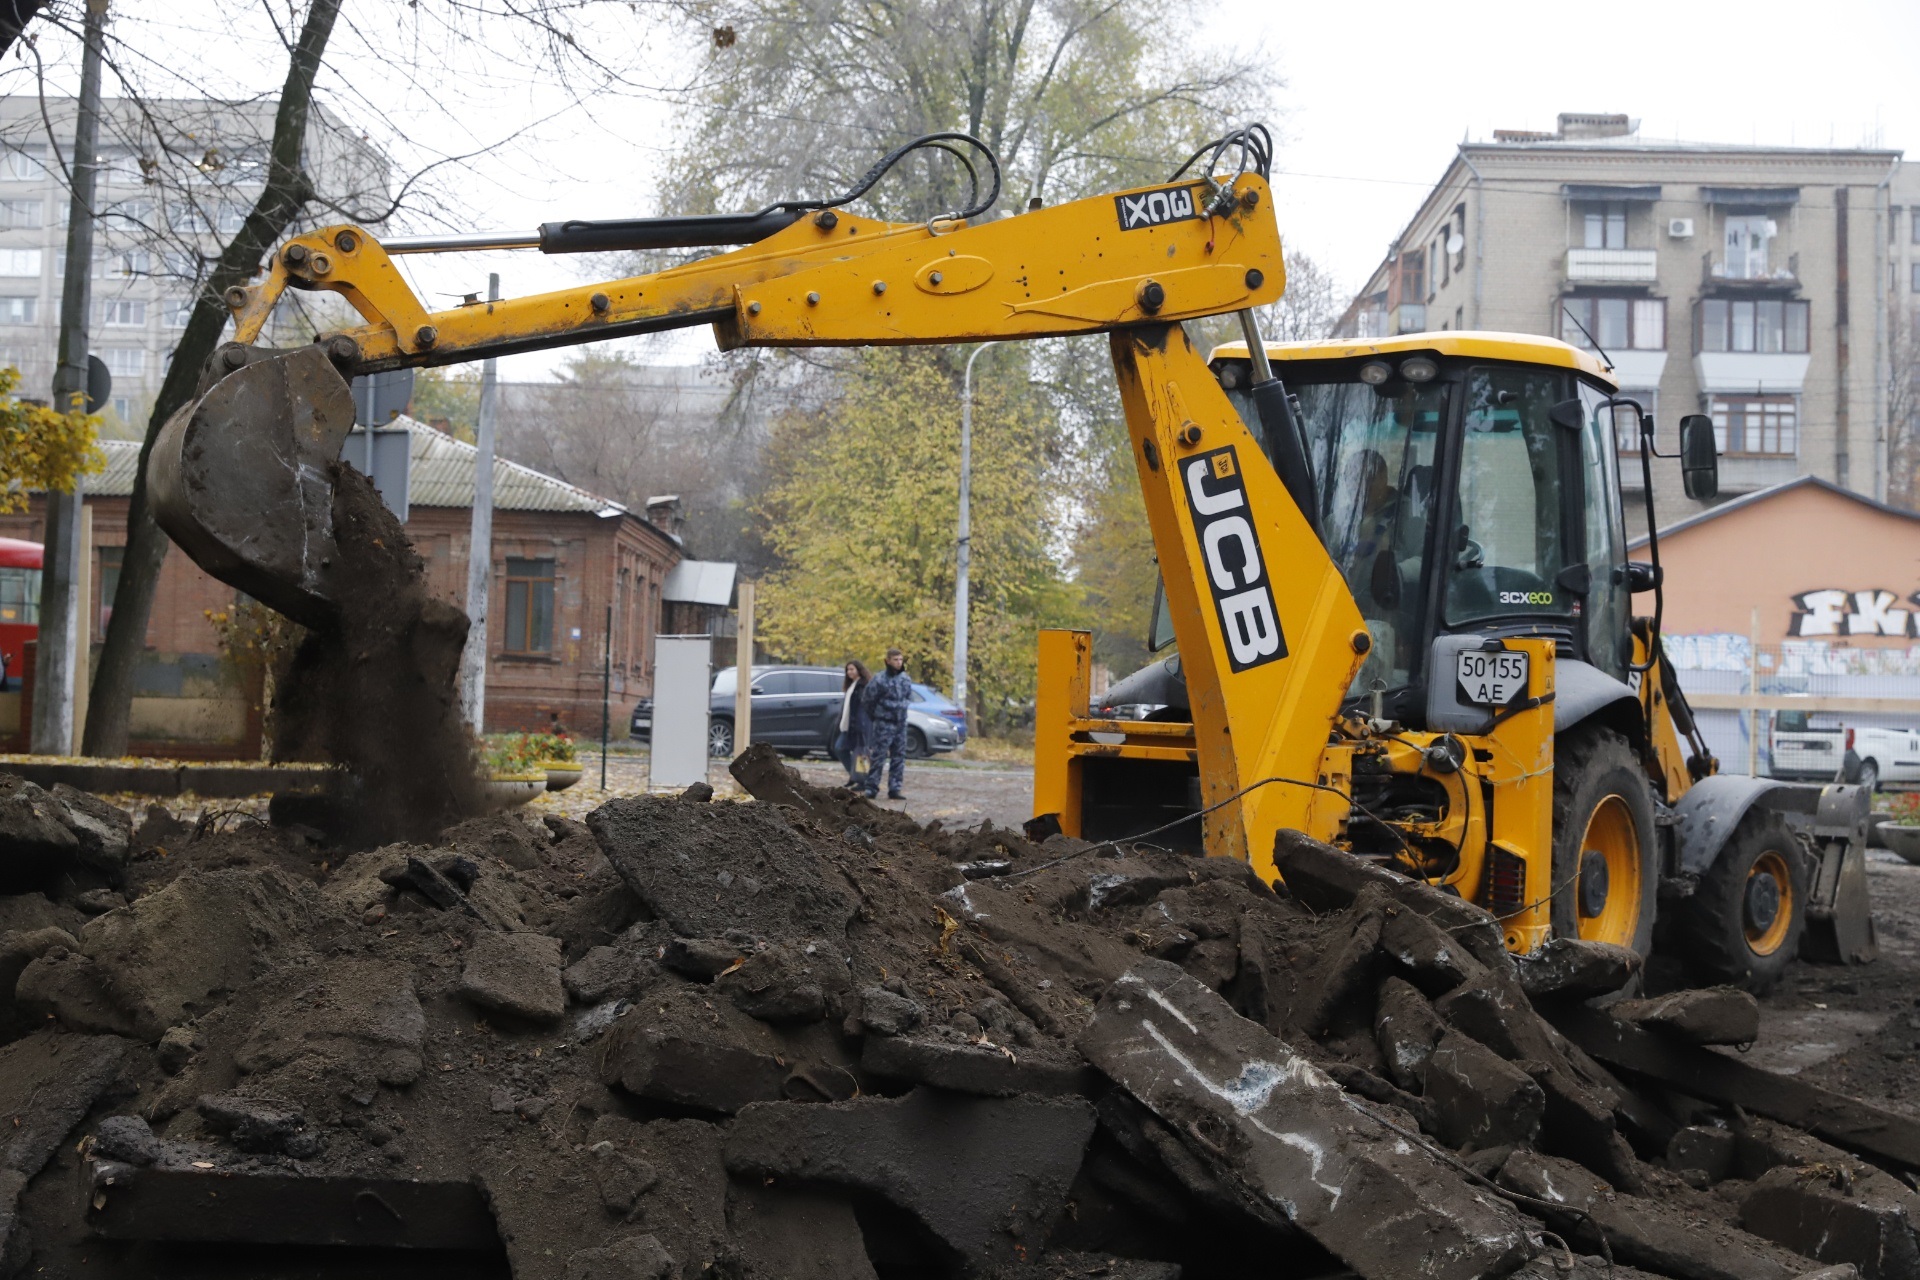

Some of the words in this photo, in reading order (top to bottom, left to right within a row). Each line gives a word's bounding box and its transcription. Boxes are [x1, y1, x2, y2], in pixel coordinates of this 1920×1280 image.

[1124, 189, 1193, 229] 3CX
[1187, 459, 1279, 664] JCB
[1499, 591, 1553, 605] 3CXeco
[1462, 656, 1522, 679] 50155
[1477, 683, 1503, 701] AE
